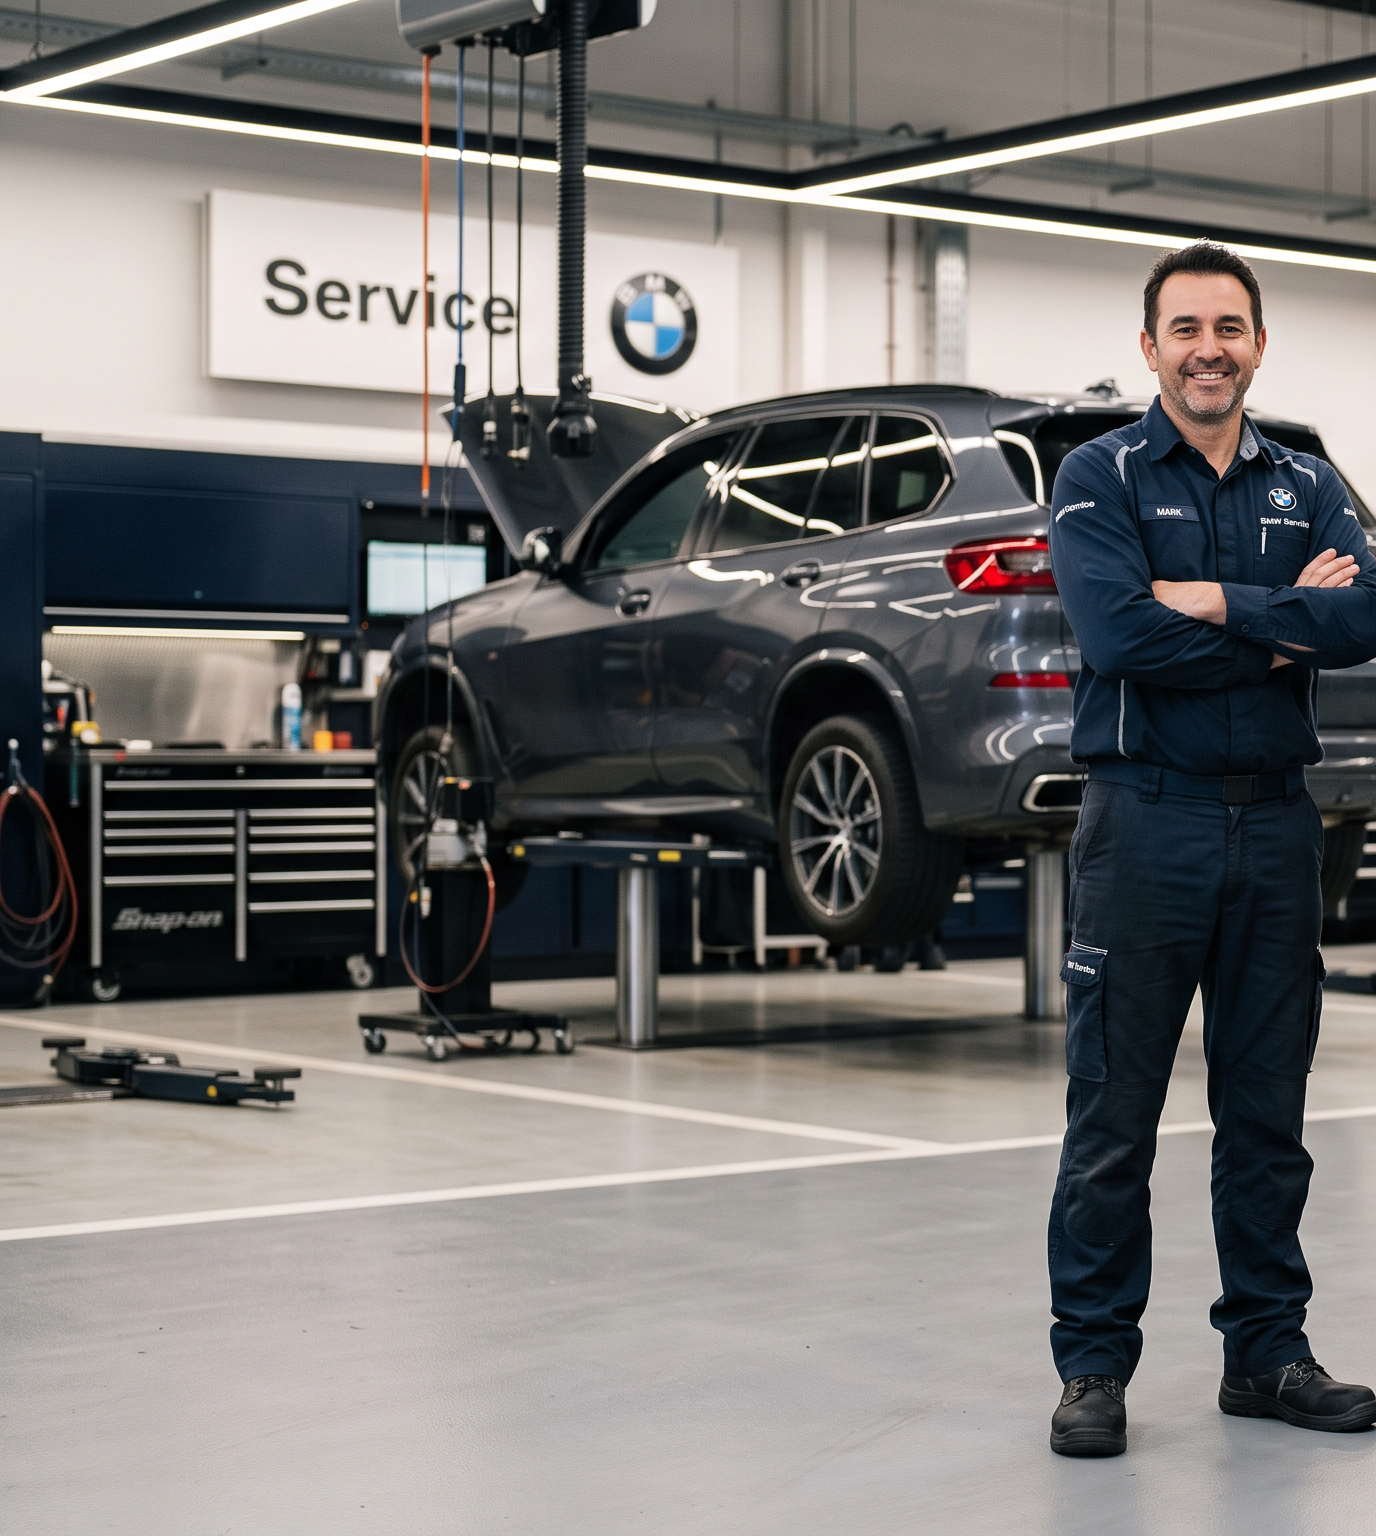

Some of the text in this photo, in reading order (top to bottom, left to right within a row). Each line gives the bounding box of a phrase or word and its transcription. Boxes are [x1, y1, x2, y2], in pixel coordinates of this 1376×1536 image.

[264, 258, 515, 335] Service
[1156, 507, 1184, 517] MARK
[1260, 517, 1282, 525] BMW
[111, 907, 224, 934] Snap-on
